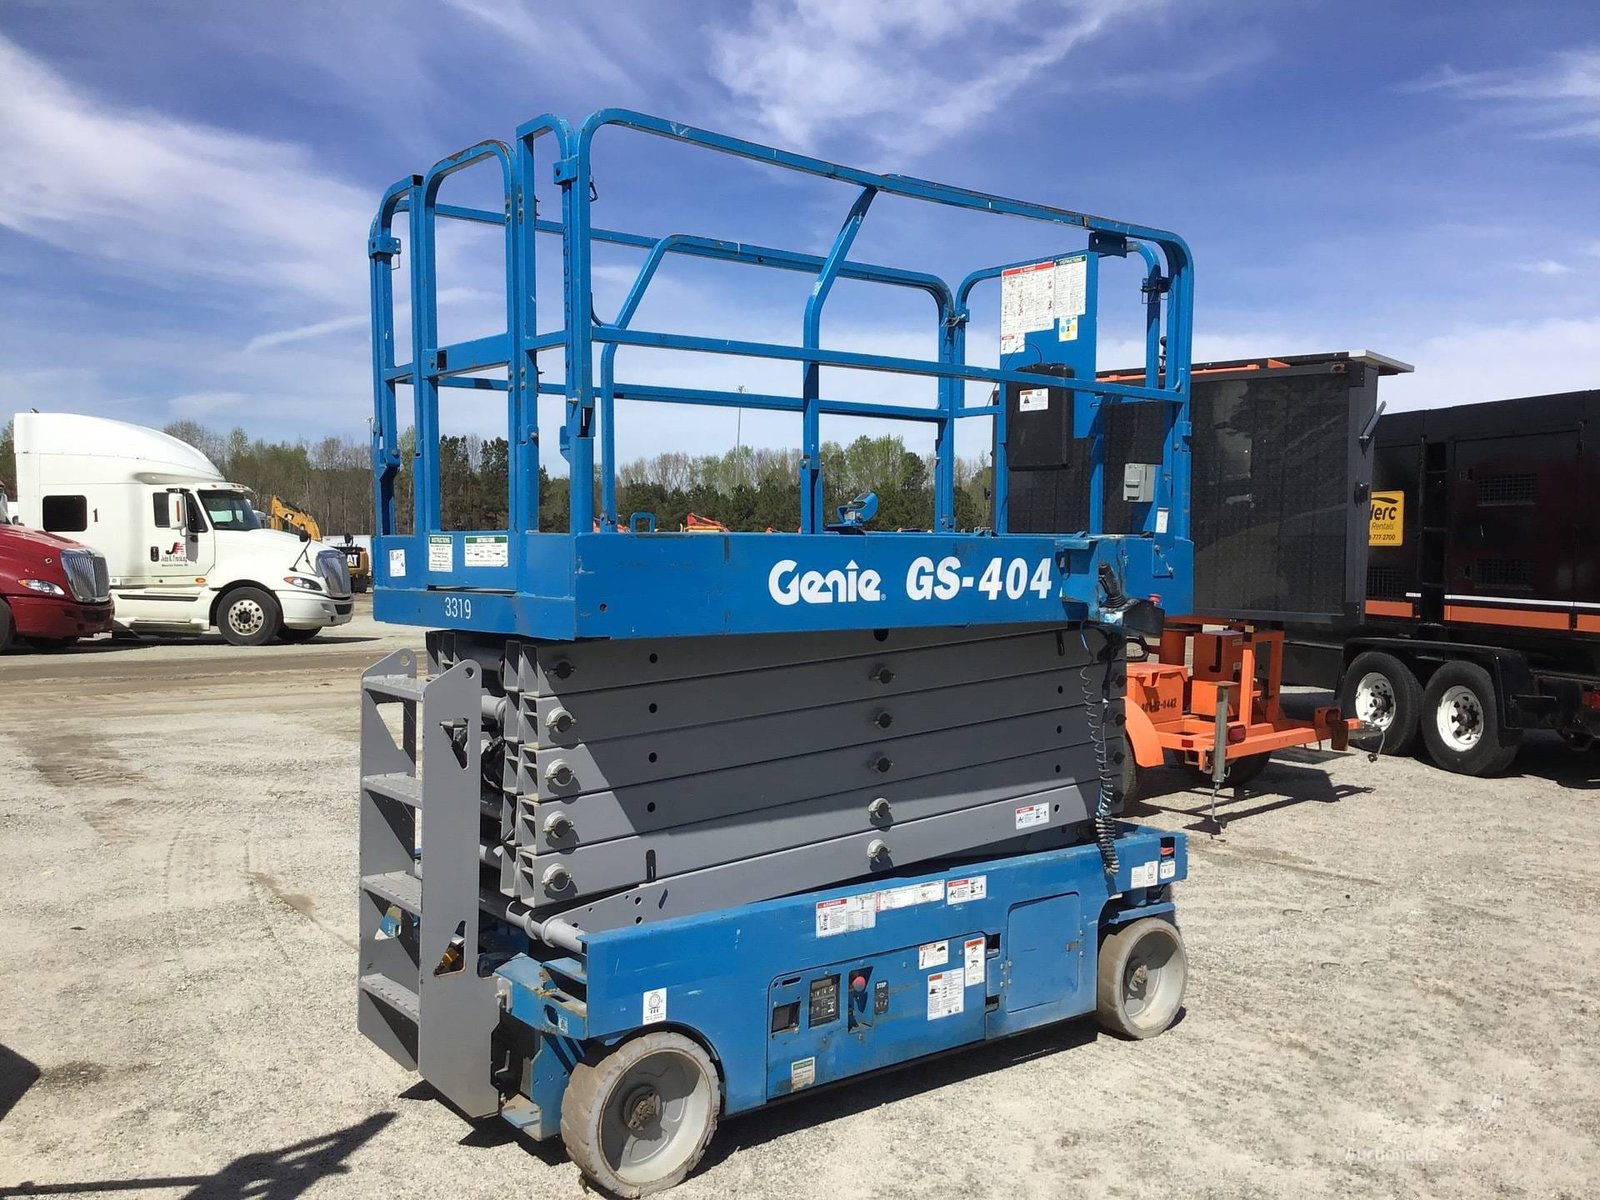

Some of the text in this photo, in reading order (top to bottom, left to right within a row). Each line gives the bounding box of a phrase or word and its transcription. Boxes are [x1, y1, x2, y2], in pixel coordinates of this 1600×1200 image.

[1371, 522, 1394, 530] Rentals
[346, 554, 359, 567] AT
[768, 556, 1064, 606] Genie GS-404
[444, 596, 472, 620] 3319
